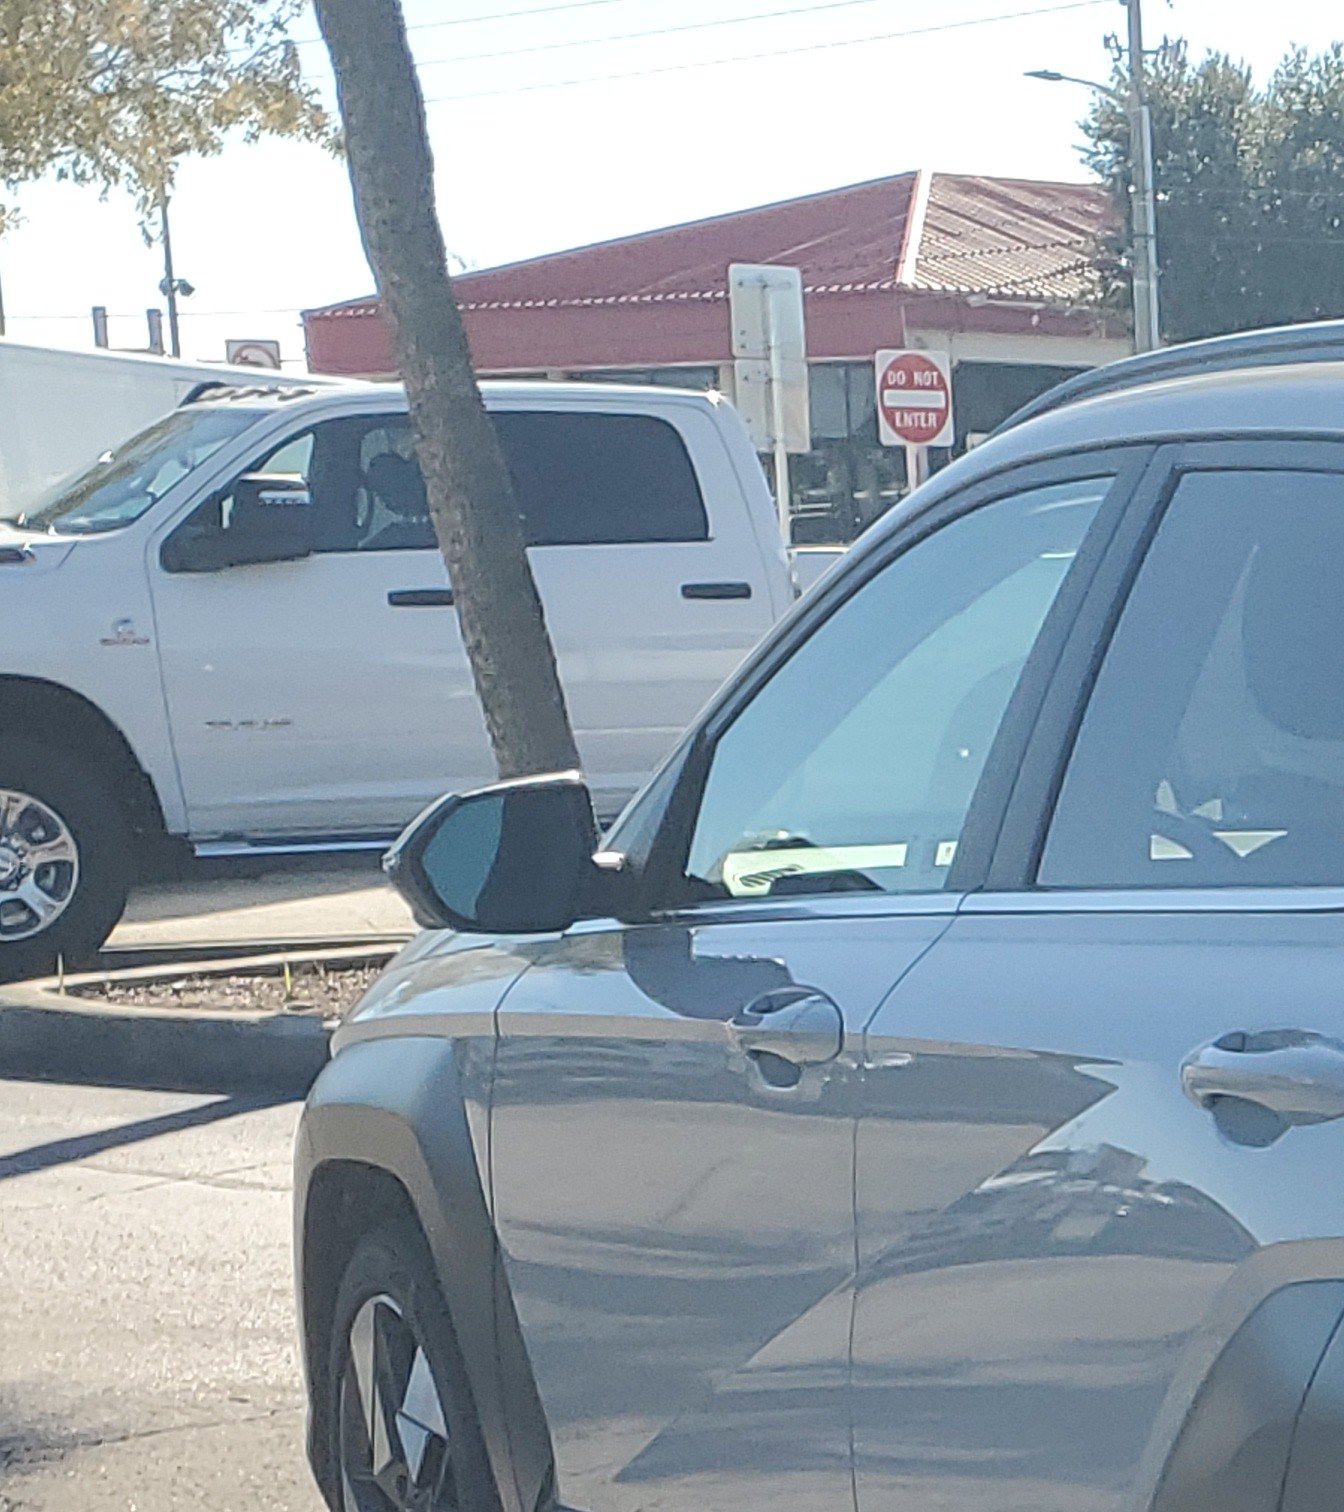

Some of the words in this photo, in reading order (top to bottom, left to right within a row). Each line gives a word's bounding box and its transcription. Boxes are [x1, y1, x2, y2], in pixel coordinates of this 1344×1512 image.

[887, 370, 906, 386] DO
[913, 371, 938, 387] NOT
[895, 411, 937, 428] ENTER
